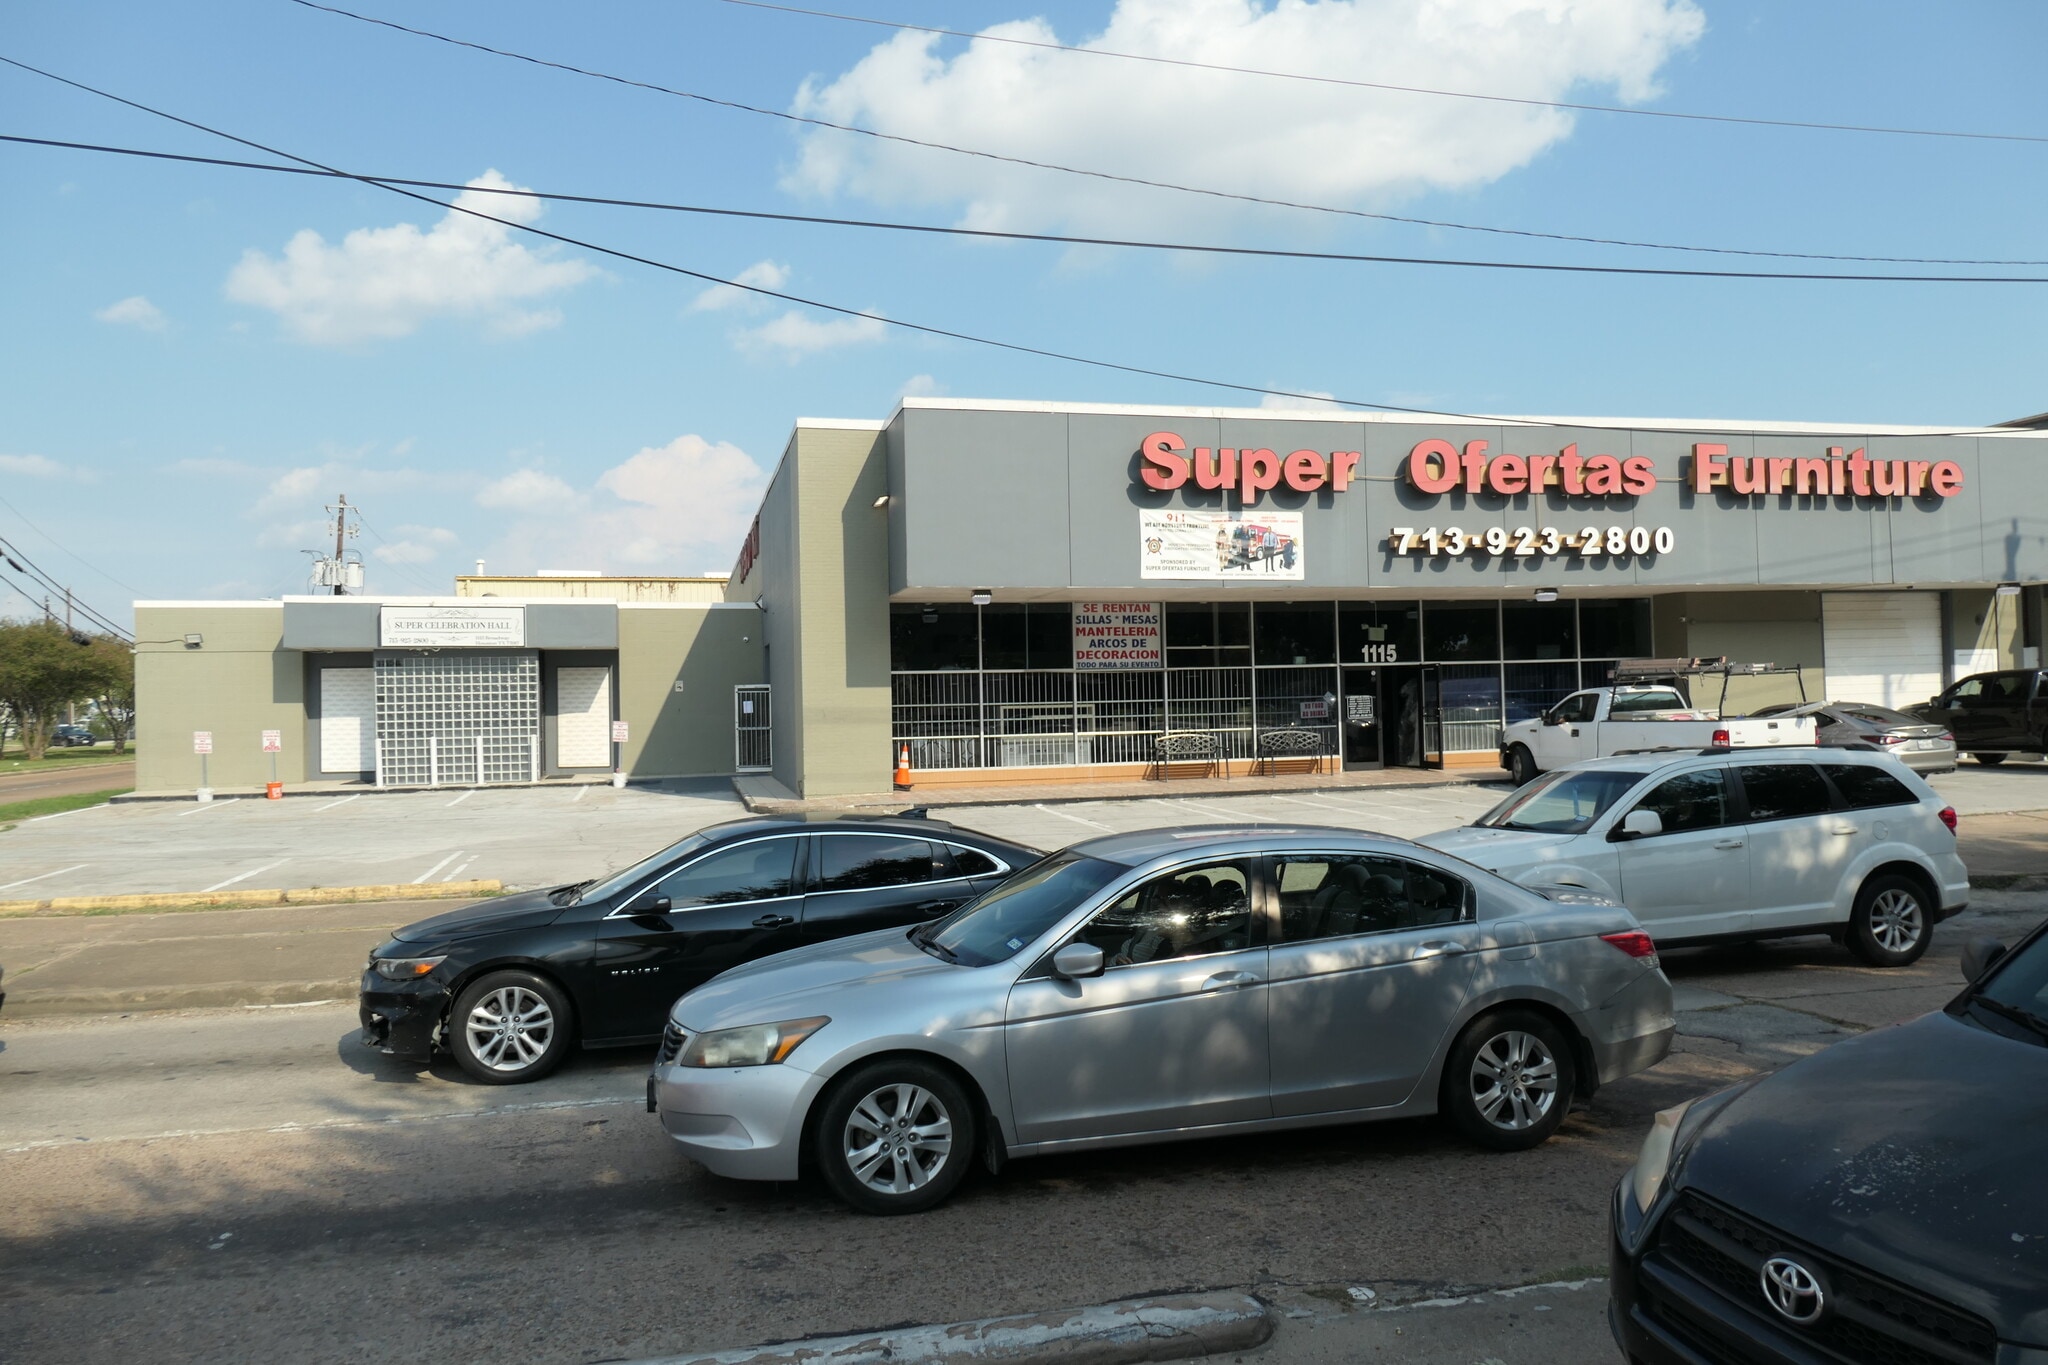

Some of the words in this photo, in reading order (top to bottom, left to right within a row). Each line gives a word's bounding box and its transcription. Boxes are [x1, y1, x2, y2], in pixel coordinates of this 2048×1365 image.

[1140, 431, 1361, 504] Super
[1408, 438, 1657, 496] Ofertas
[1692, 442, 1965, 498] Furniture
[1083, 603, 1098, 613] SE
[1102, 603, 1151, 613] RENTAN
[1075, 615, 1112, 625] SILLAS
[1122, 615, 1158, 625] MESAS
[394, 621, 425, 630] SUPER
[425, 621, 486, 630] CELEBRATION
[488, 621, 512, 630] HALL
[1075, 626, 1158, 637] MANTELERIA
[1089, 638, 1128, 648] ARCOS
[1132, 639, 1147, 648] DE
[1076, 650, 1159, 660] DECORACION
[1361, 644, 1398, 663] 1115
